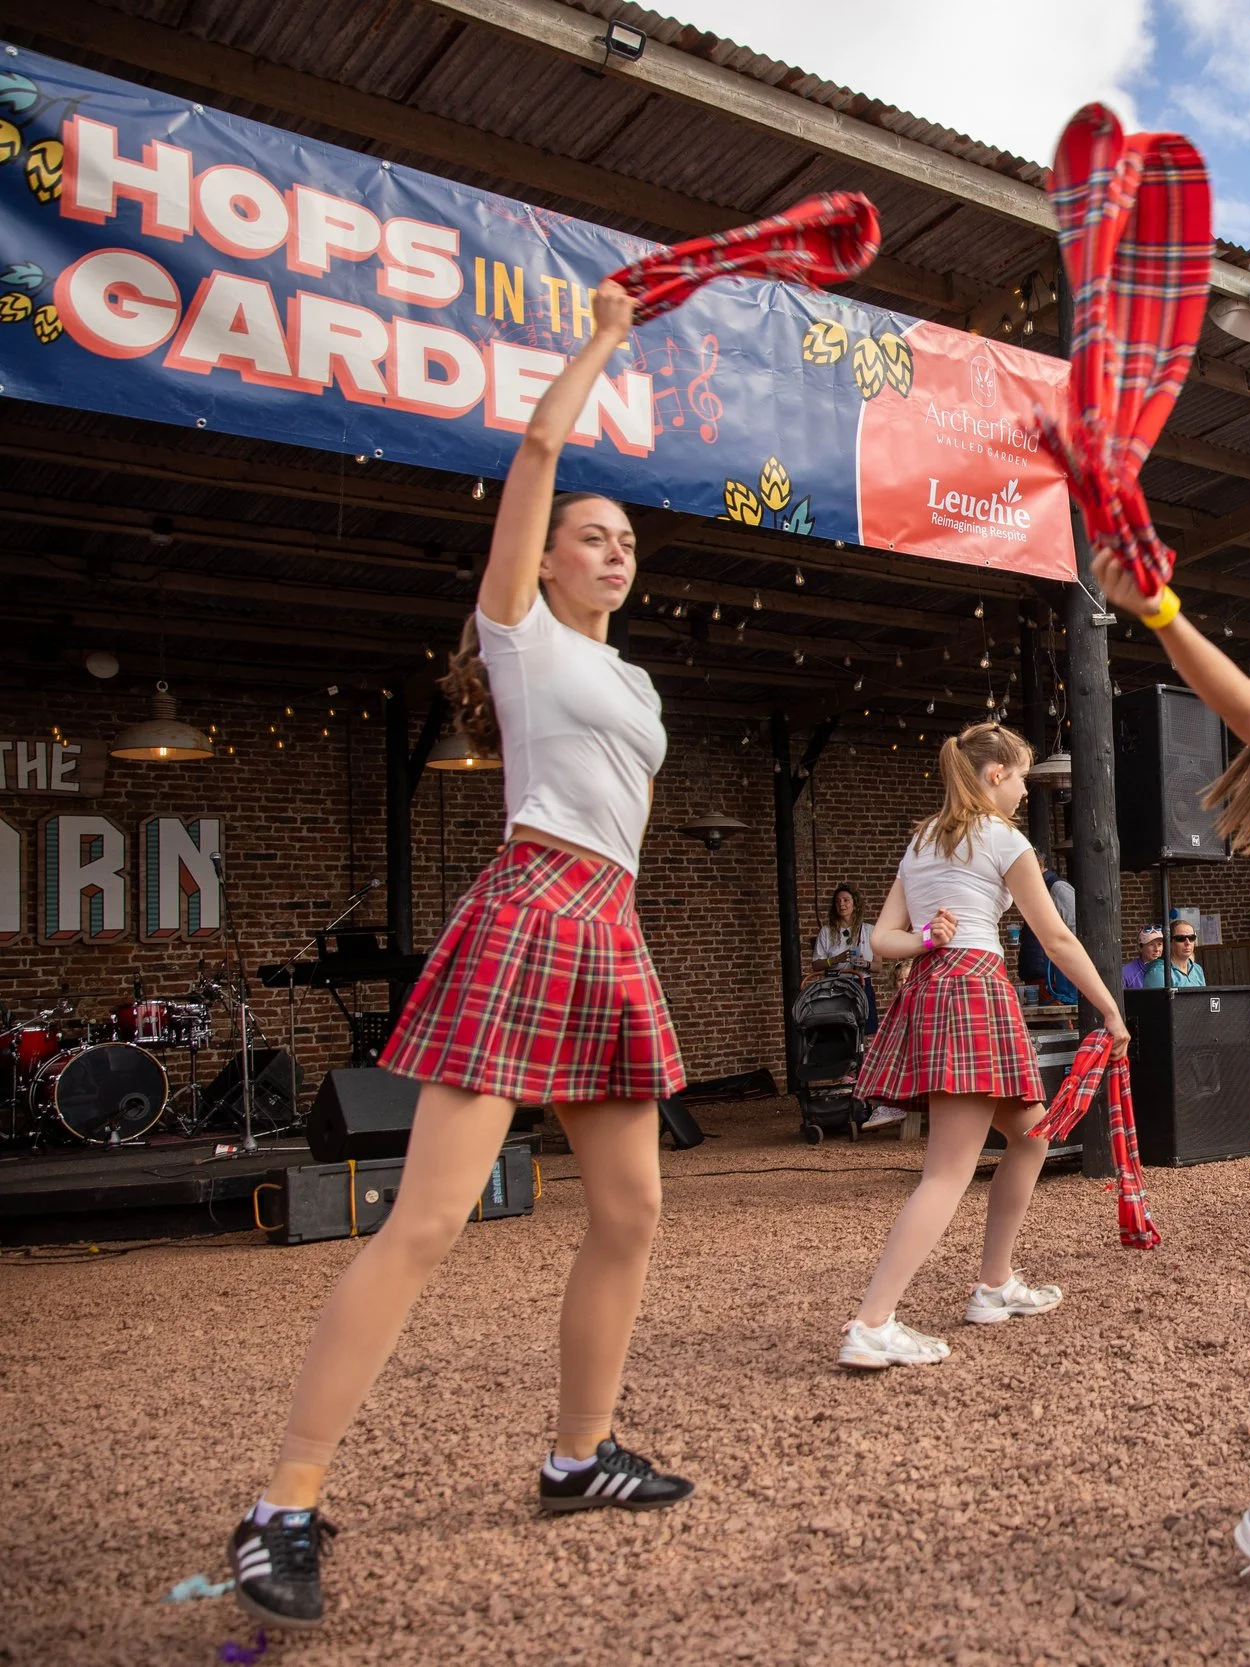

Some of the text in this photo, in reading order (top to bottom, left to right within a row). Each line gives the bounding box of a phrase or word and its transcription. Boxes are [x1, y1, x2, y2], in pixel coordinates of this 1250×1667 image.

[60, 114, 630, 350] HOPS IN TH
[54, 248, 655, 458] GARDEN
[925, 401, 1040, 453] Archerfield
[936, 433, 1028, 467] WALLED GARDEN
[927, 477, 1031, 529] Leuchie
[931, 511, 1027, 542] Reimagining Respite
